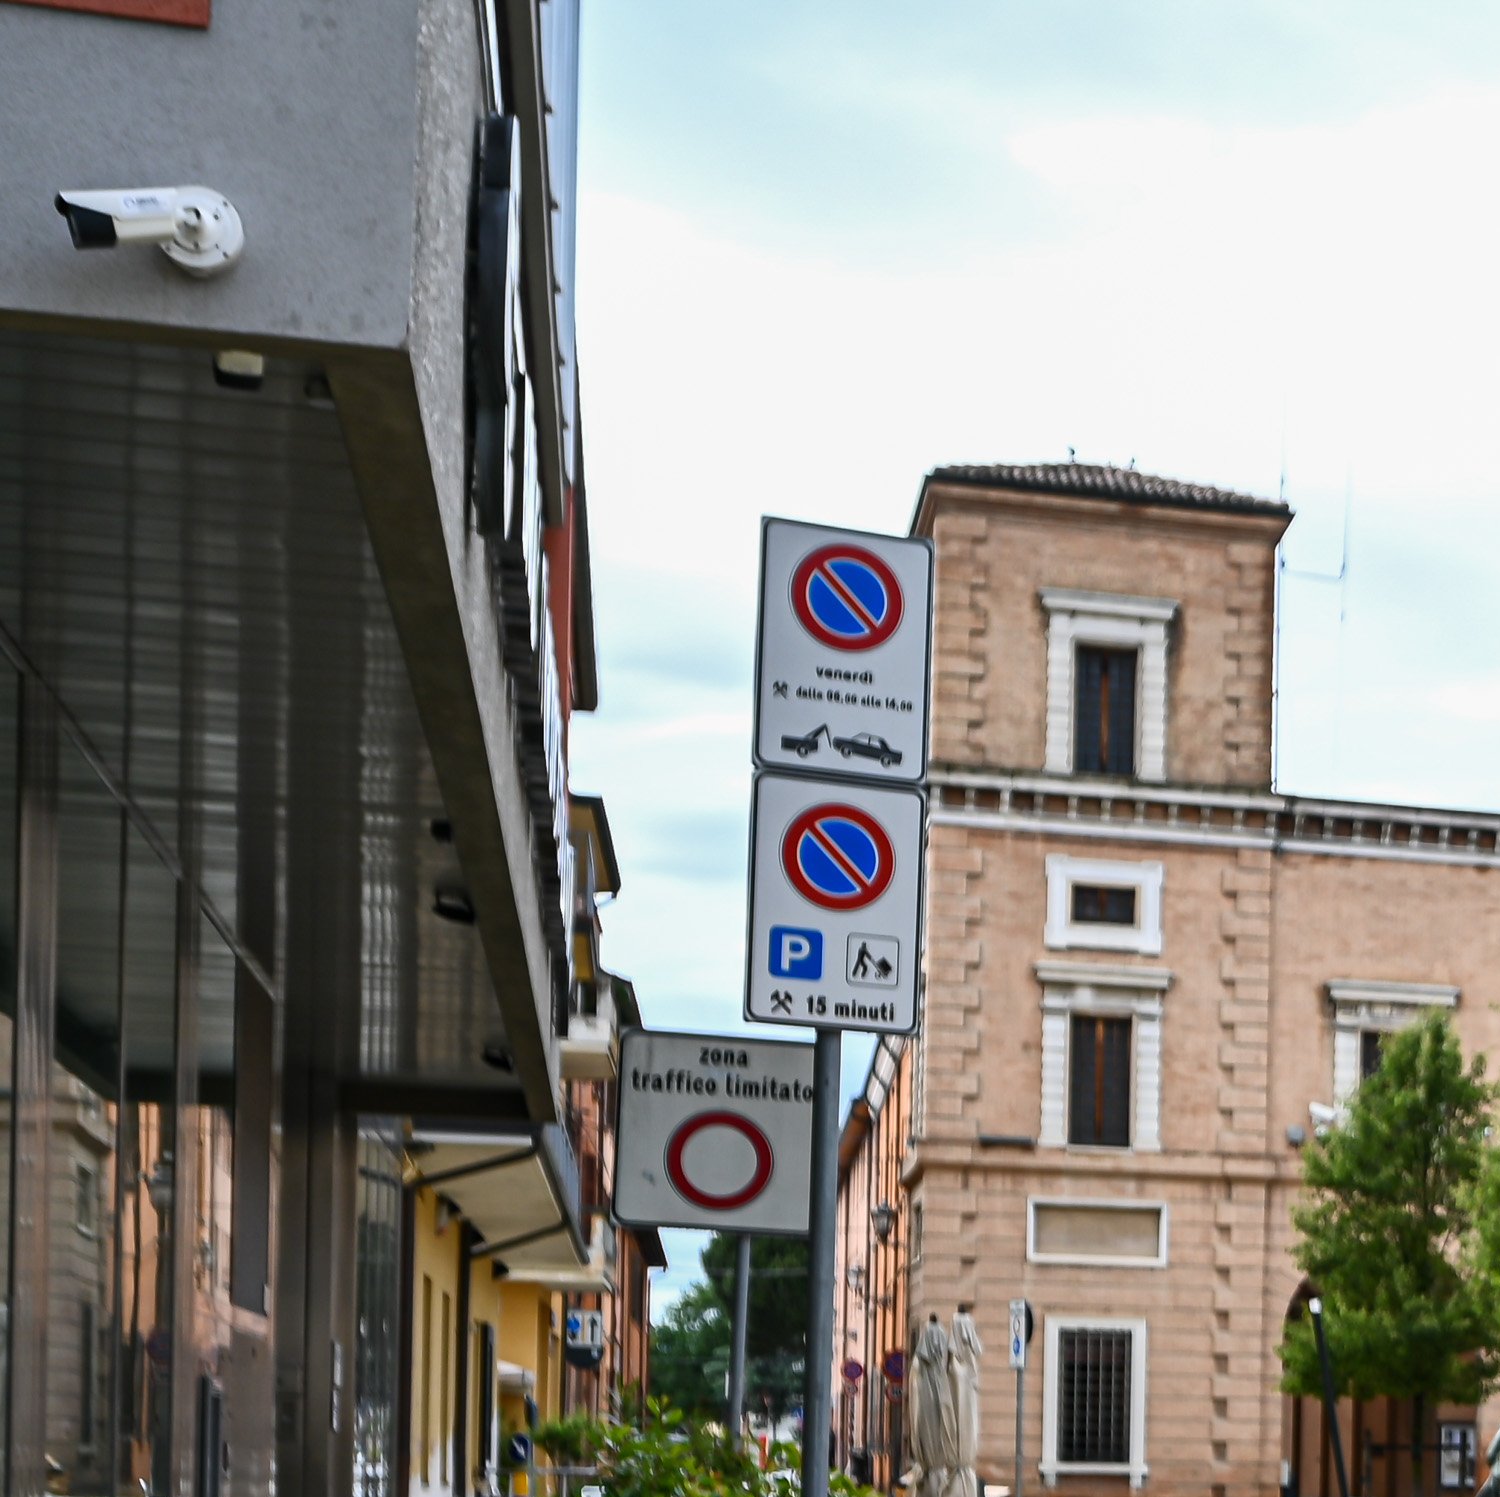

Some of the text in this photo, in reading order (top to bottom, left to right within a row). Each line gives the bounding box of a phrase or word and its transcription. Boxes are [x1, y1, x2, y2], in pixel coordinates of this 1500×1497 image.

[795, 685, 823, 700] dalle
[860, 694, 882, 708] alle
[780, 933, 811, 973] P
[806, 994, 895, 1023] 15 minuti
[699, 1046, 749, 1068] zona
[632, 1066, 814, 1103] traffico limitato
